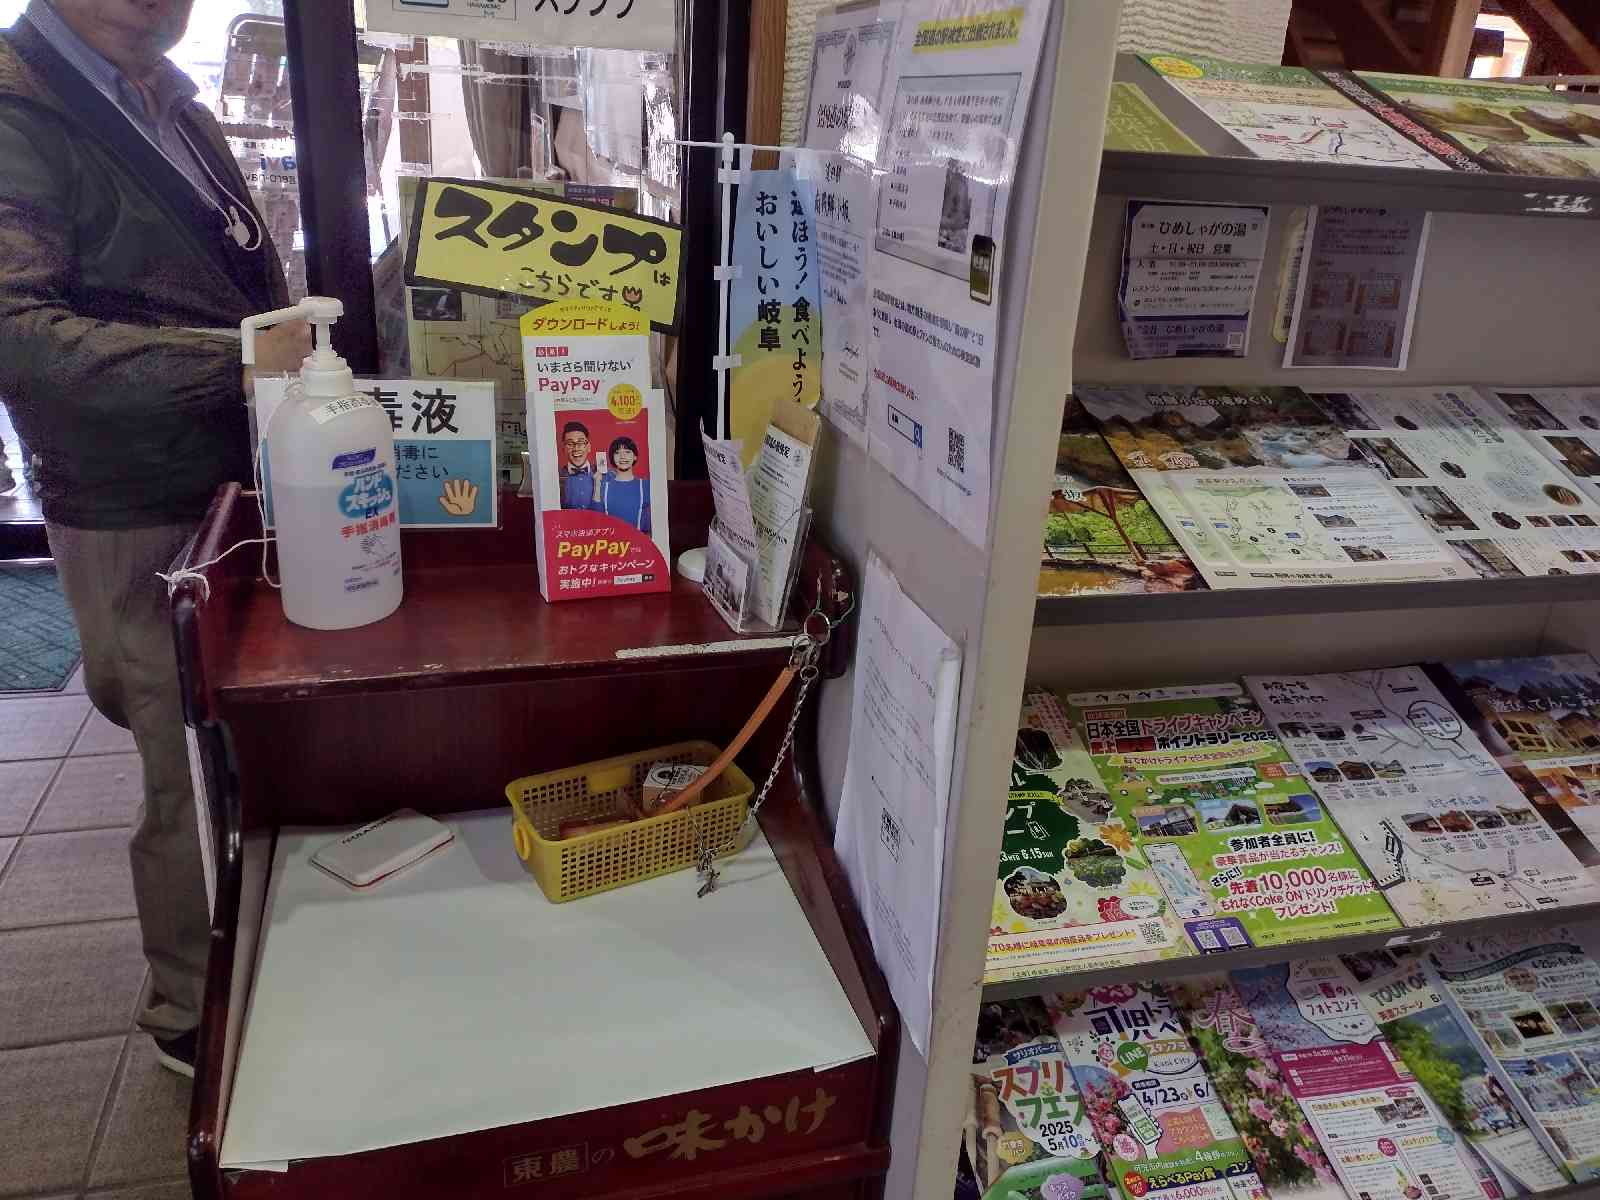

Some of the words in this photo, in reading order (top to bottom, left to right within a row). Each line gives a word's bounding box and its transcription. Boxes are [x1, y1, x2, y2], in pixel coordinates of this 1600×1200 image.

[434, 186, 667, 275] スタンプ
[1160, 221, 1247, 237] ひめしゃがの湯
[653, 270, 671, 287] は
[755, 191, 782, 352] おいしい岐阜
[519, 266, 618, 302] こちらです
[537, 359, 632, 374] いまさら聞けない
[538, 377, 600, 394] PayPay
[558, 560, 656, 576] おトクなキャンペーン
[1157, 730, 1278, 750] ポイントラリー2025
[1230, 831, 1315, 852] 参加者全員に!
[1274, 902, 1336, 919] プレゼント!
[1120, 1047, 1147, 1065] LINE
[1040, 1121, 1074, 1138] 2025
